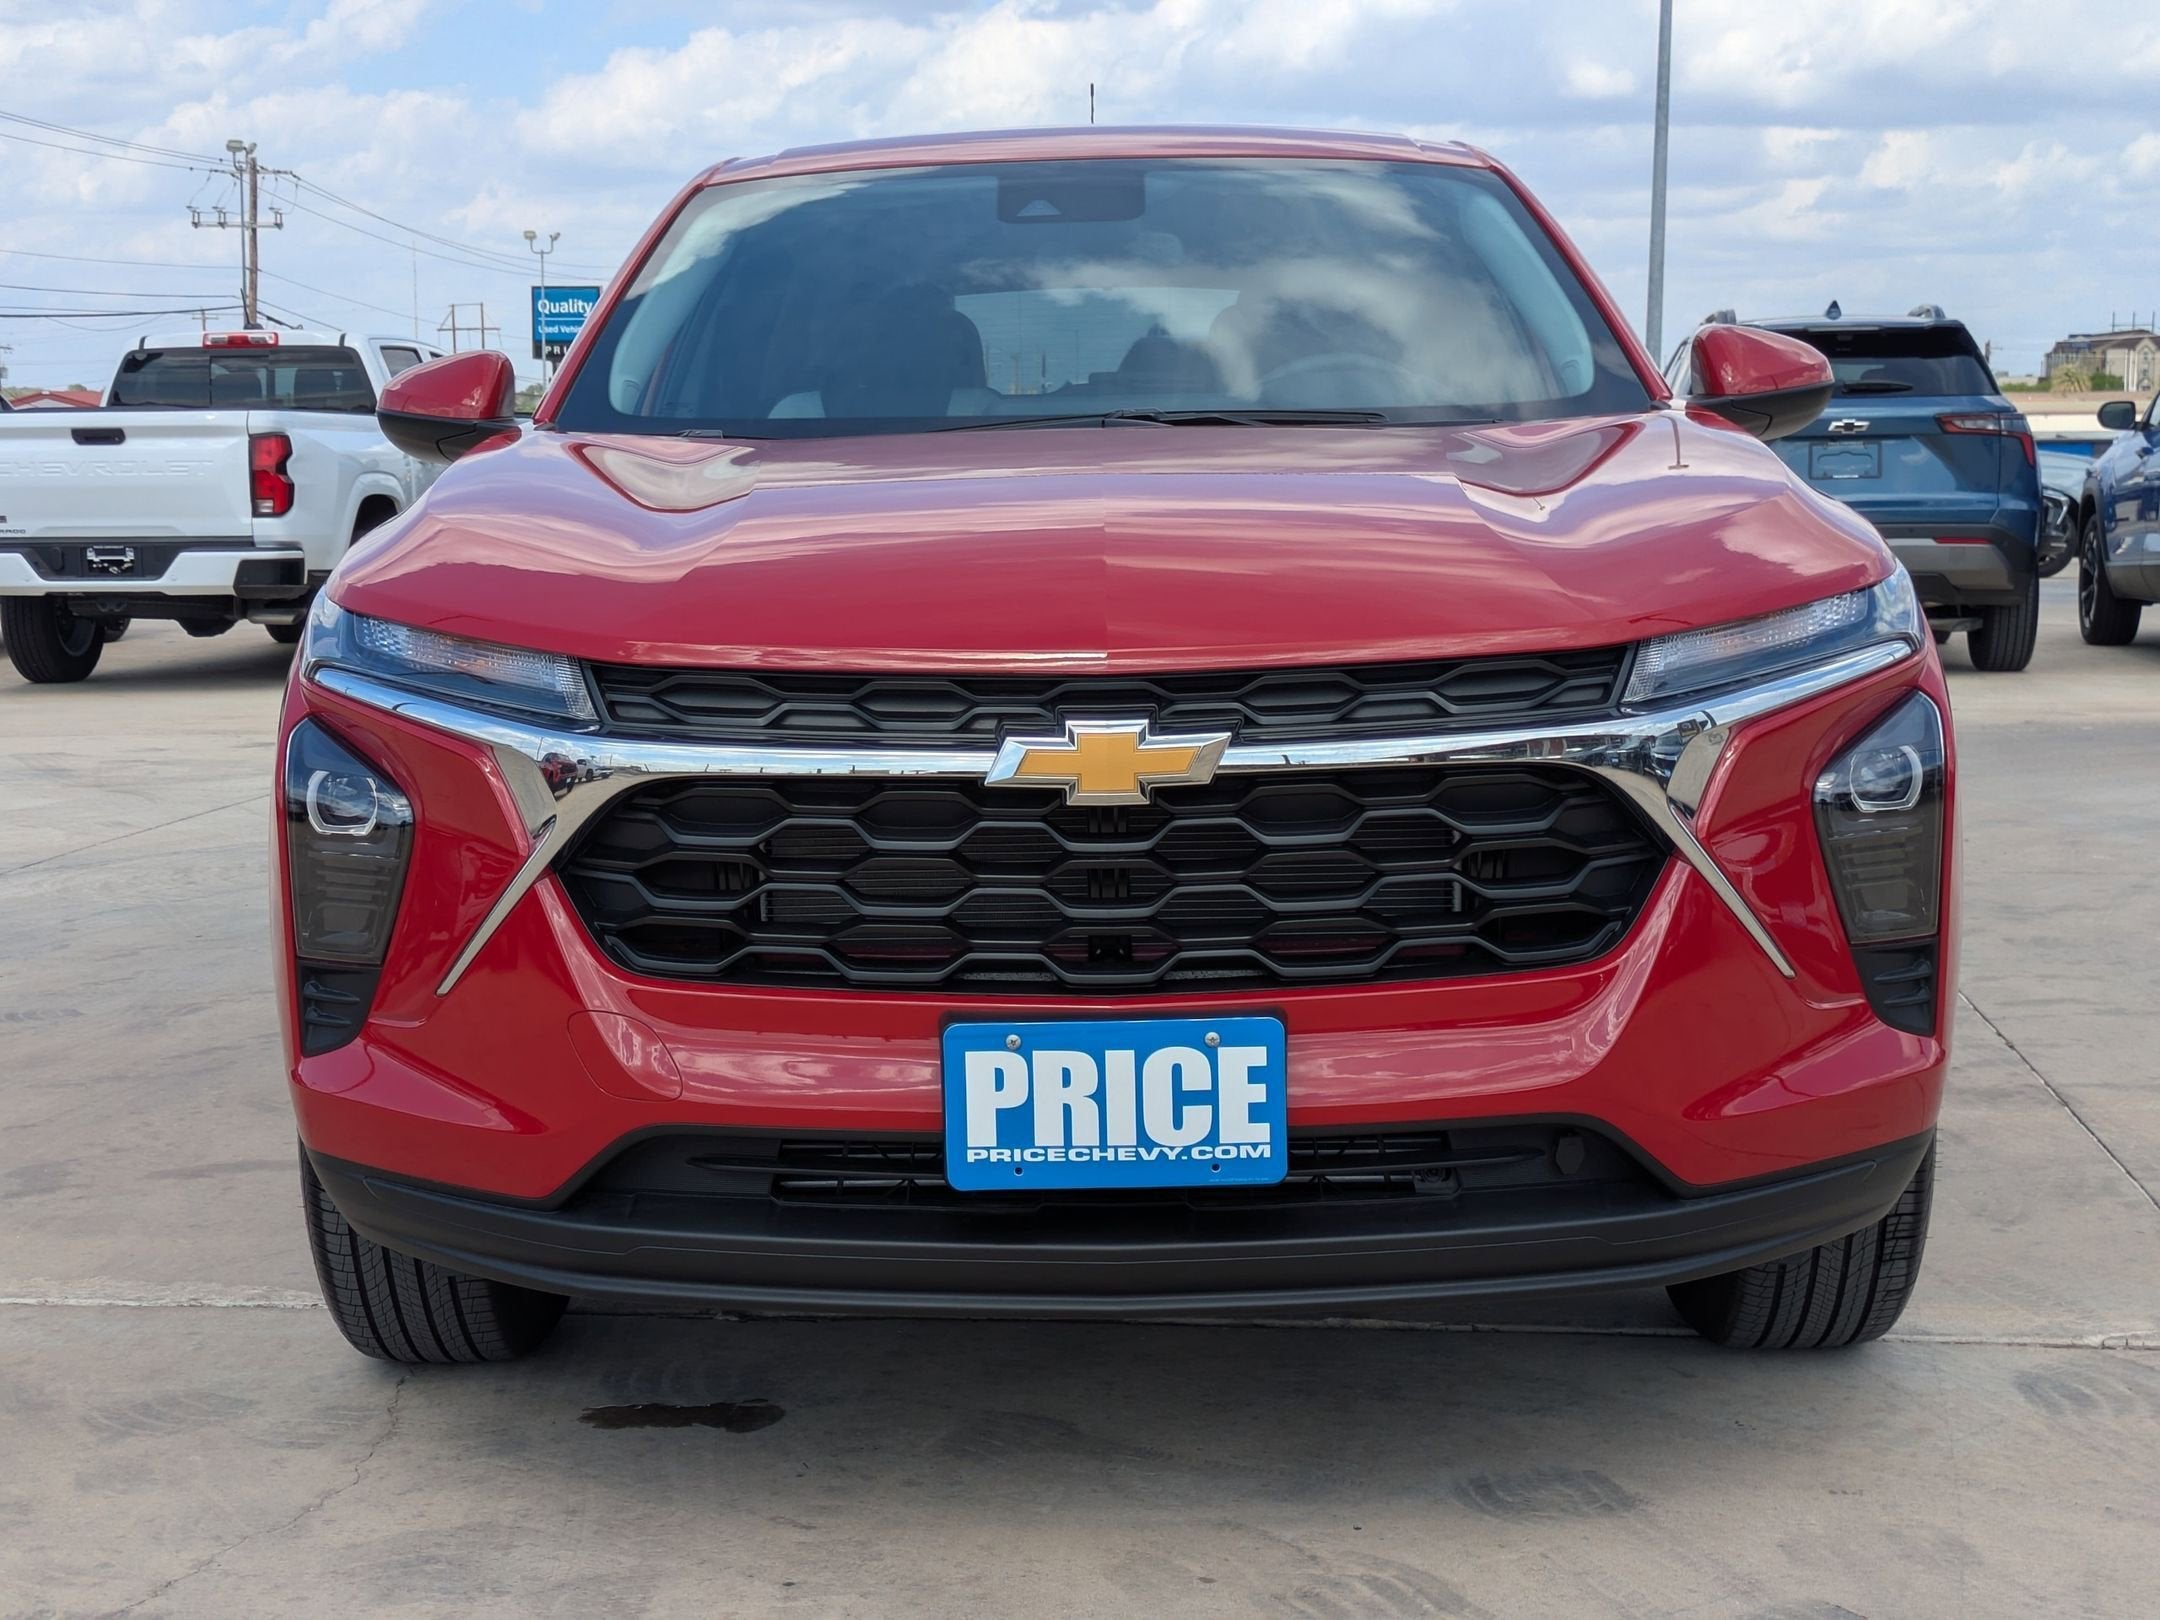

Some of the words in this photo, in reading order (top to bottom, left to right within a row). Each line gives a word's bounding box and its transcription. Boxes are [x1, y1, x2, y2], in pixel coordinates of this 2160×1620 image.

[537, 298, 592, 317] Quality
[964, 1046, 1271, 1148] PRICE
[966, 1144, 1271, 1163] PRICECHEVY.COM
